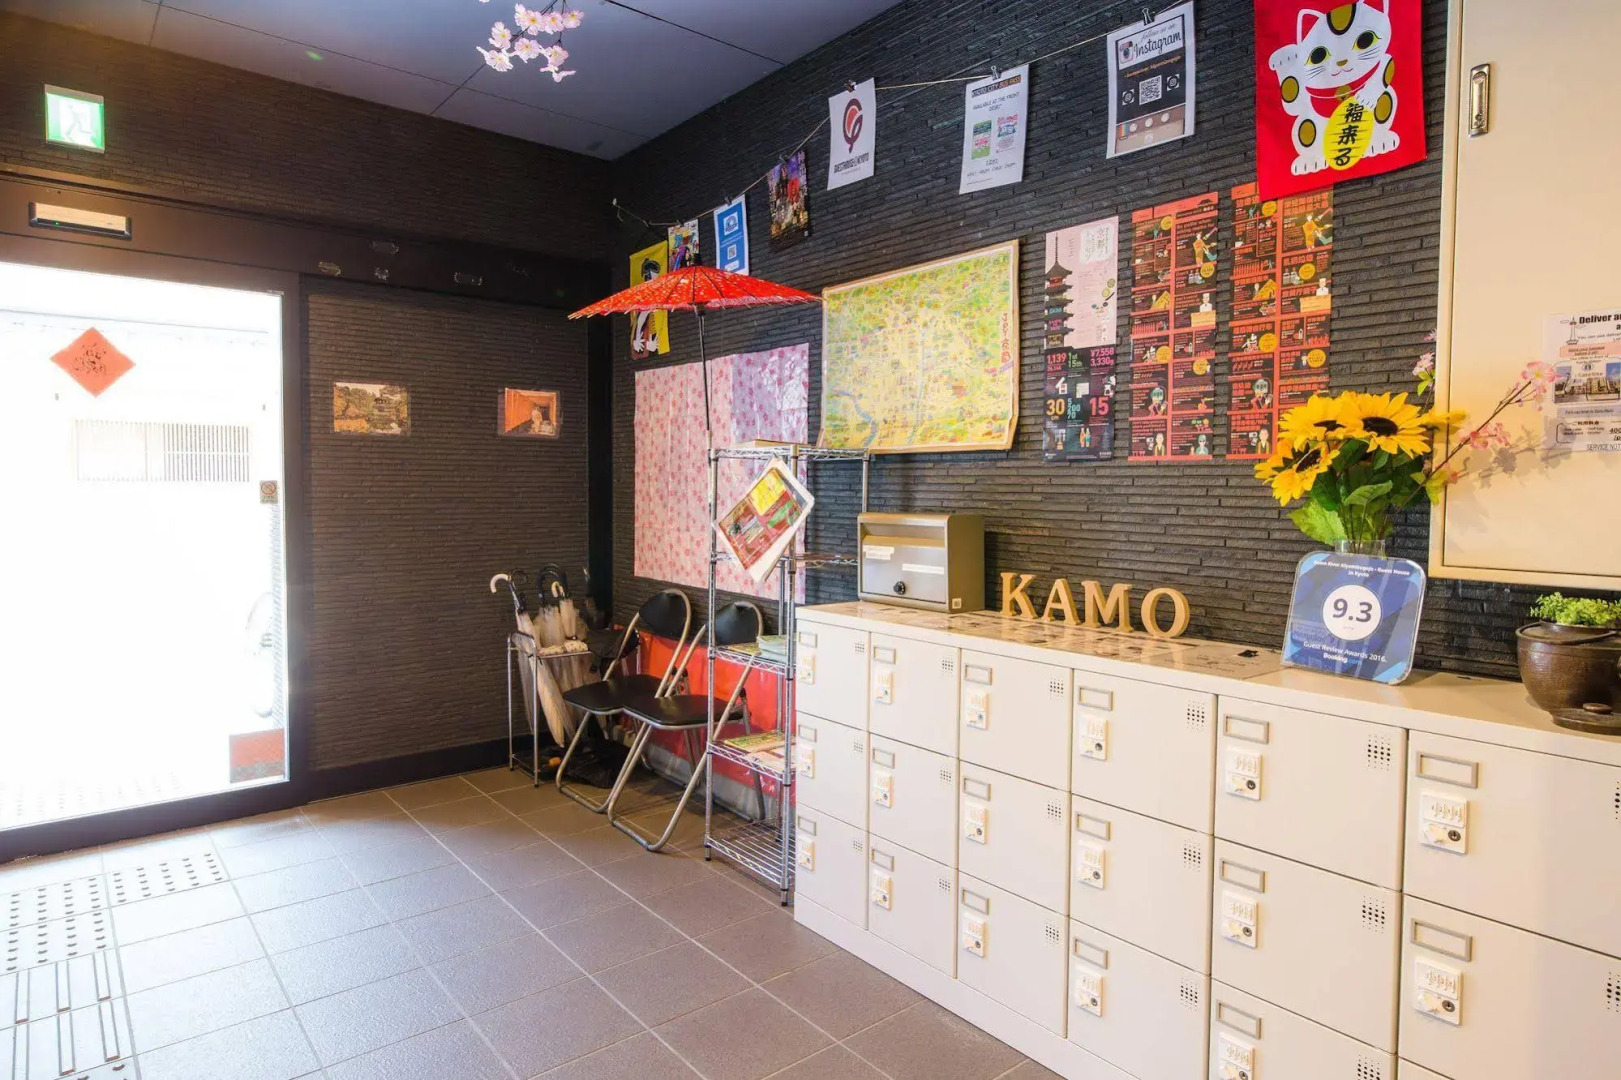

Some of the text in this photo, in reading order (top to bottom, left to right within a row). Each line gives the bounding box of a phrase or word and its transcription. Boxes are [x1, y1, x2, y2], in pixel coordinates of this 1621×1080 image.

[1134, 32, 1182, 59] Instagram
[1334, 103, 1364, 166] 福来る
[1579, 315, 1611, 324] Deliver
[1047, 353, 1067, 364] 1,139
[1046, 398, 1065, 416] 30
[1090, 396, 1109, 416] 15
[1000, 572, 1190, 639] KAMO
[1333, 598, 1373, 622] 9.3
[1303, 641, 1320, 649] Guest
[1322, 645, 1343, 653] Review
[1344, 649, 1368, 659] Awards
